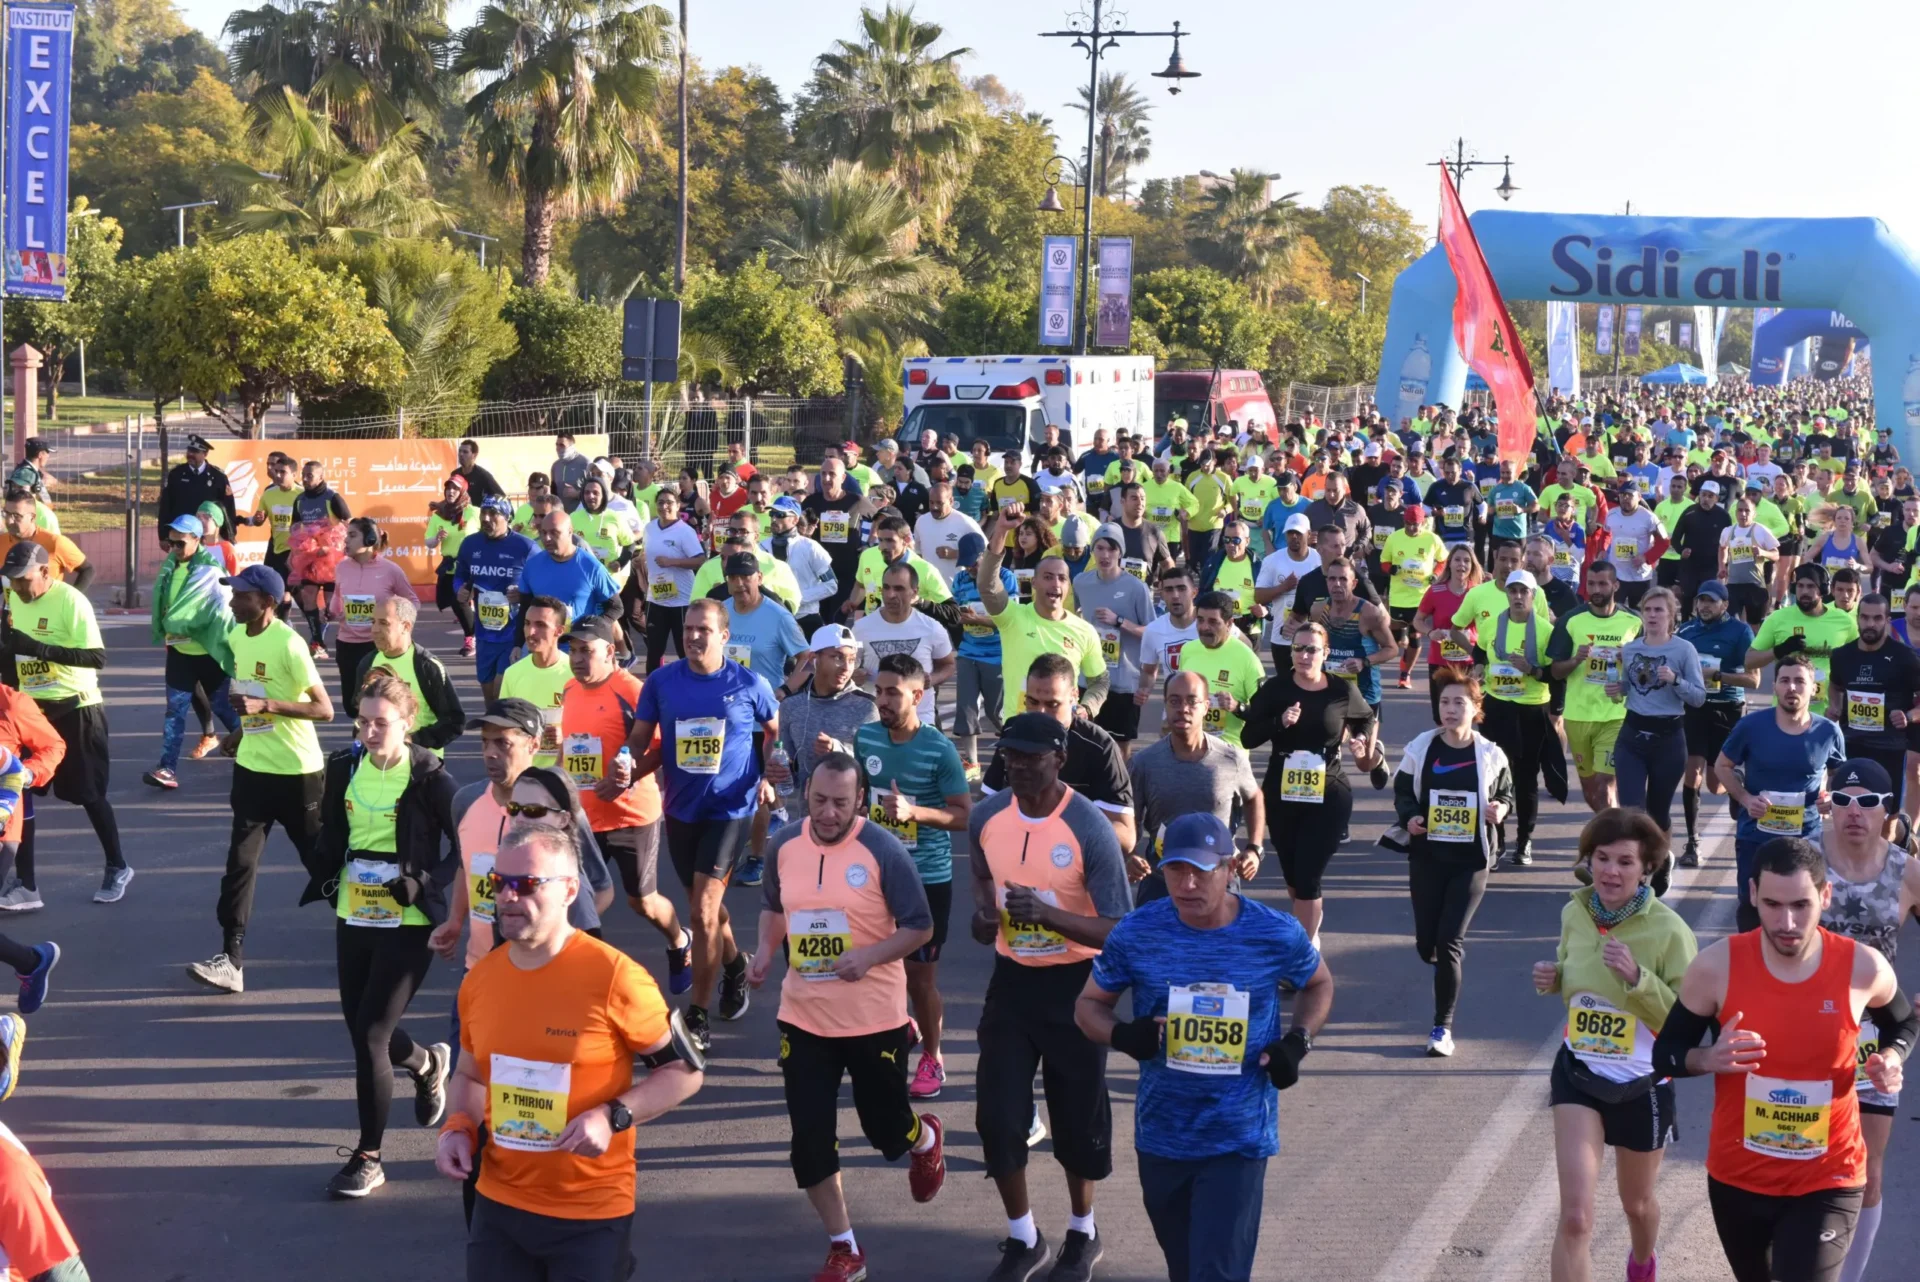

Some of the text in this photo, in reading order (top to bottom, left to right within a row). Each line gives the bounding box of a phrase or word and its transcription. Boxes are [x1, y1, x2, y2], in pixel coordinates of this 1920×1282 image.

[12, 11, 70, 27] INSTITUT
[24, 35, 51, 249] EXCEL
[1550, 235, 1782, 301] Sidi ali
[823, 523, 845, 532] 5798
[396, 546, 409, 557] 64
[470, 565, 514, 577] FRANCE
[653, 583, 673, 593] 5507
[481, 606, 505, 618] 9703
[878, 642, 916, 651] GUESS
[20, 661, 50, 676] 8020
[1851, 703, 1879, 718] 4903
[682, 739, 721, 755] 7158
[567, 757, 597, 772] 7157
[1287, 770, 1320, 786] 8193
[1433, 807, 1471, 824] 3548
[1770, 808, 1799, 816] MADEIRA
[798, 936, 845, 957] 4280
[545, 1027, 578, 1037] Patrick
[1170, 1017, 1244, 1046] 10558
[1576, 1011, 1627, 1038] 9682
[502, 1092, 554, 1111] P. THIRION
[1767, 1090, 1808, 1106] Sidi ali
[518, 1111, 535, 1119] 9233
[1755, 1106, 1820, 1123] M. ACHHAB
[1776, 1123, 1797, 1132] 6667
